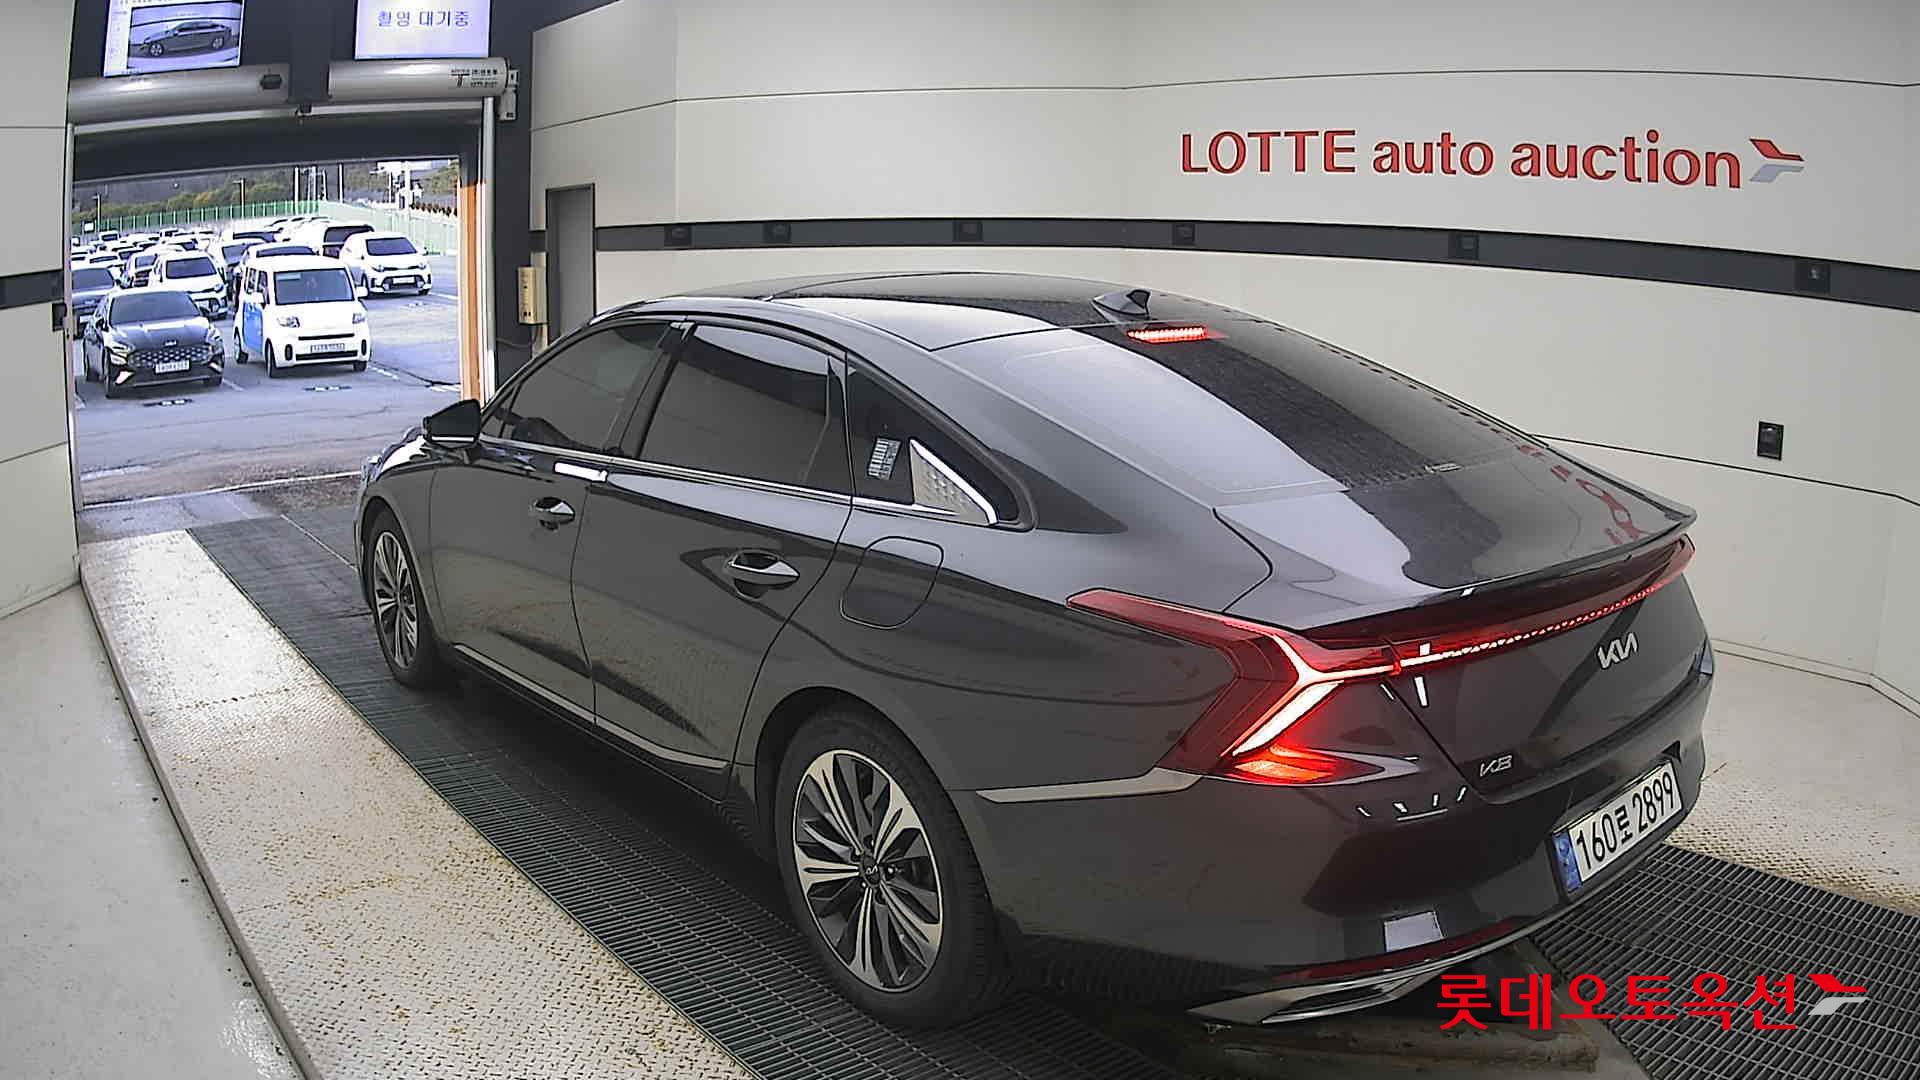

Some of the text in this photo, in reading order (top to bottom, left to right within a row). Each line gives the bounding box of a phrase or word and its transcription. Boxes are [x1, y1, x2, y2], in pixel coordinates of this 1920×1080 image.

[418, 9, 470, 28] 대기중
[1181, 129, 1742, 189] LOTTE auto auction
[1479, 754, 1513, 777] K8
[1576, 771, 1674, 871] 160로 2899
